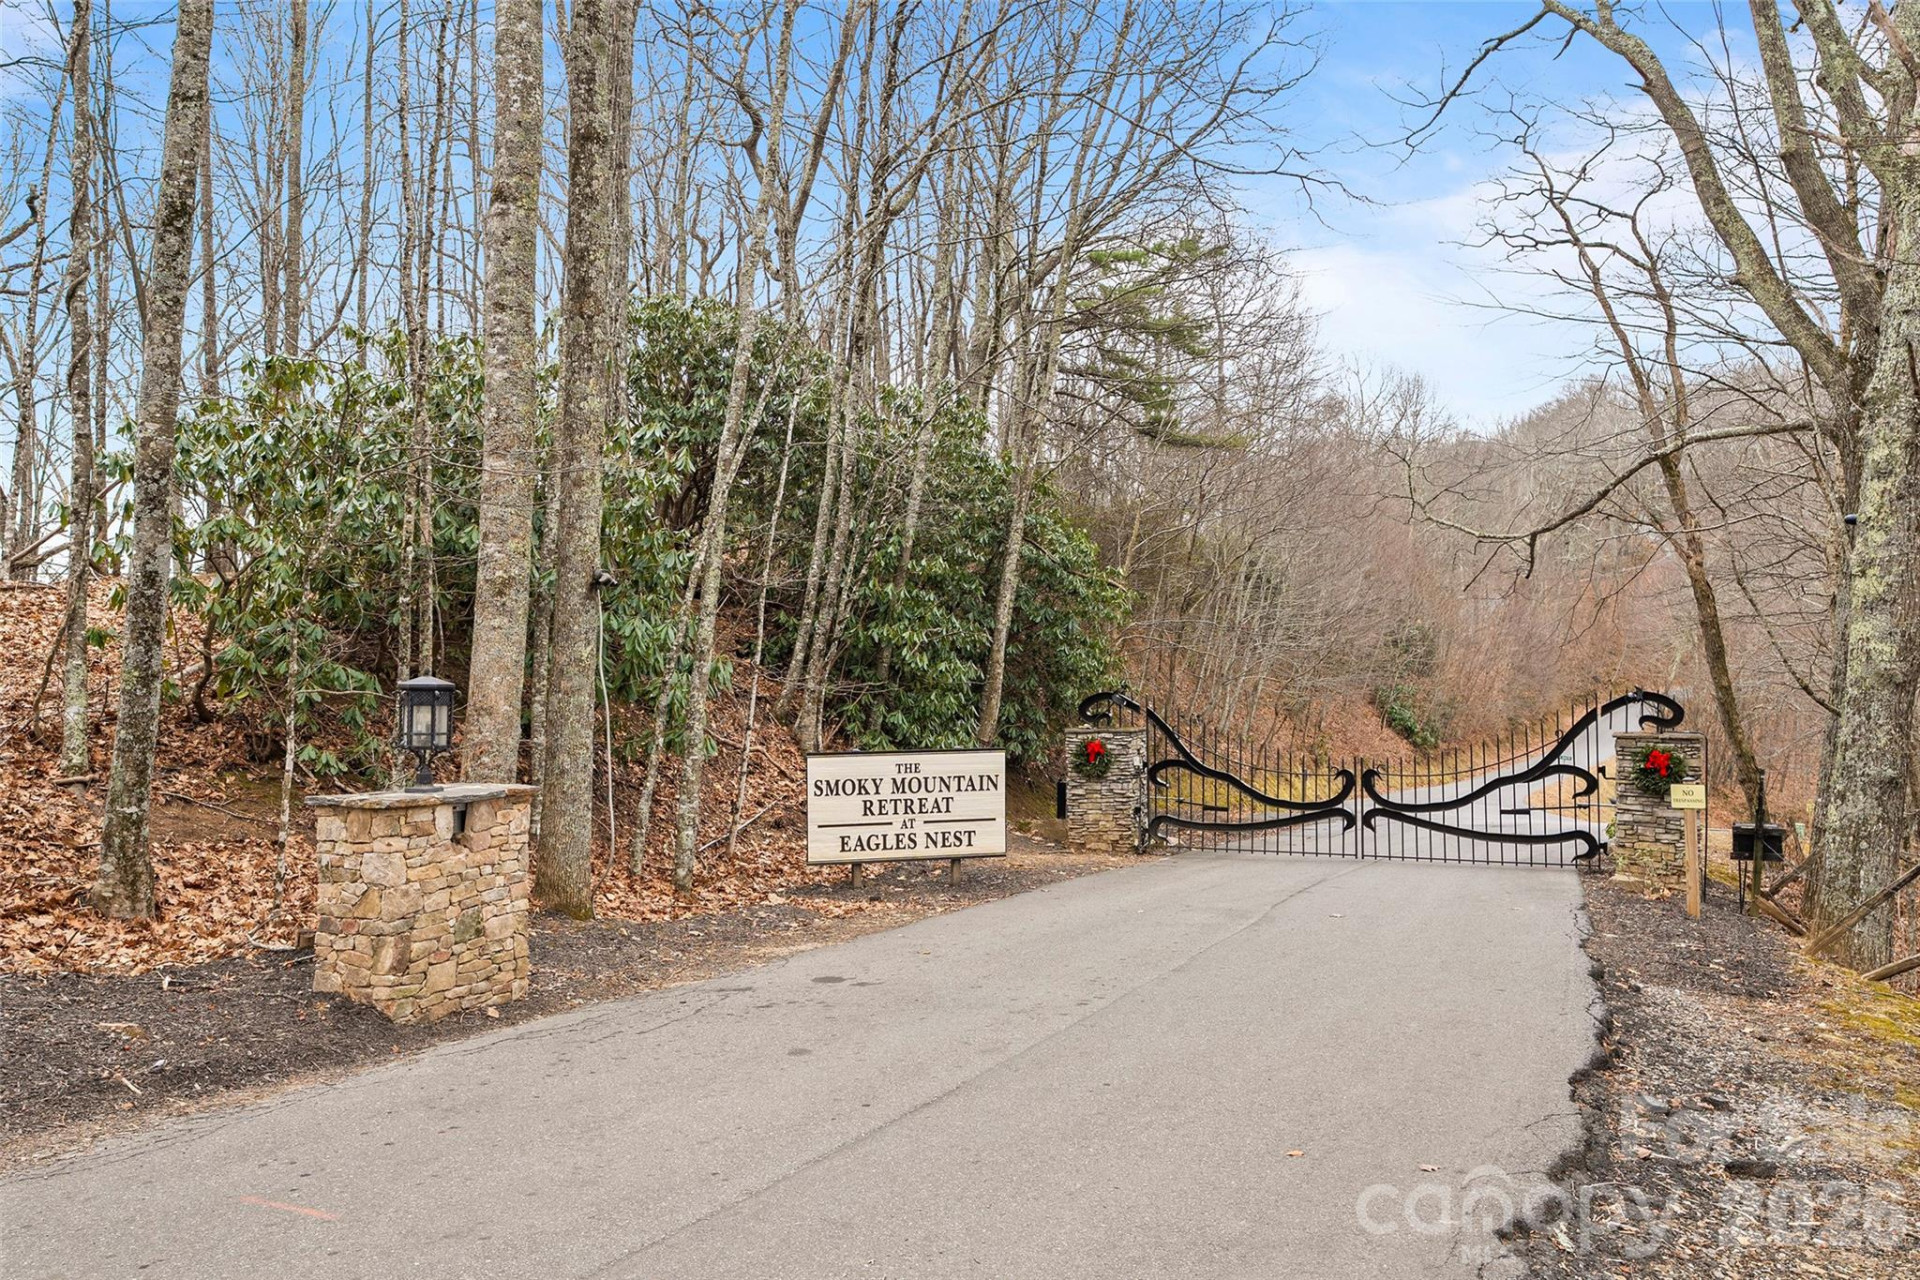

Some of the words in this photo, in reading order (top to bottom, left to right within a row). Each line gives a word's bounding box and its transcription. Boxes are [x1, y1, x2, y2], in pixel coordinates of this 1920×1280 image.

[895, 763, 921, 774] THE
[813, 778, 884, 797] SMOKY
[891, 774, 999, 795] MOUNTAIN
[1682, 789, 1695, 797] NO
[862, 797, 954, 816] RETREAT
[900, 818, 916, 830] AT
[839, 833, 918, 853] EAGLES
[925, 830, 976, 849] NEST
